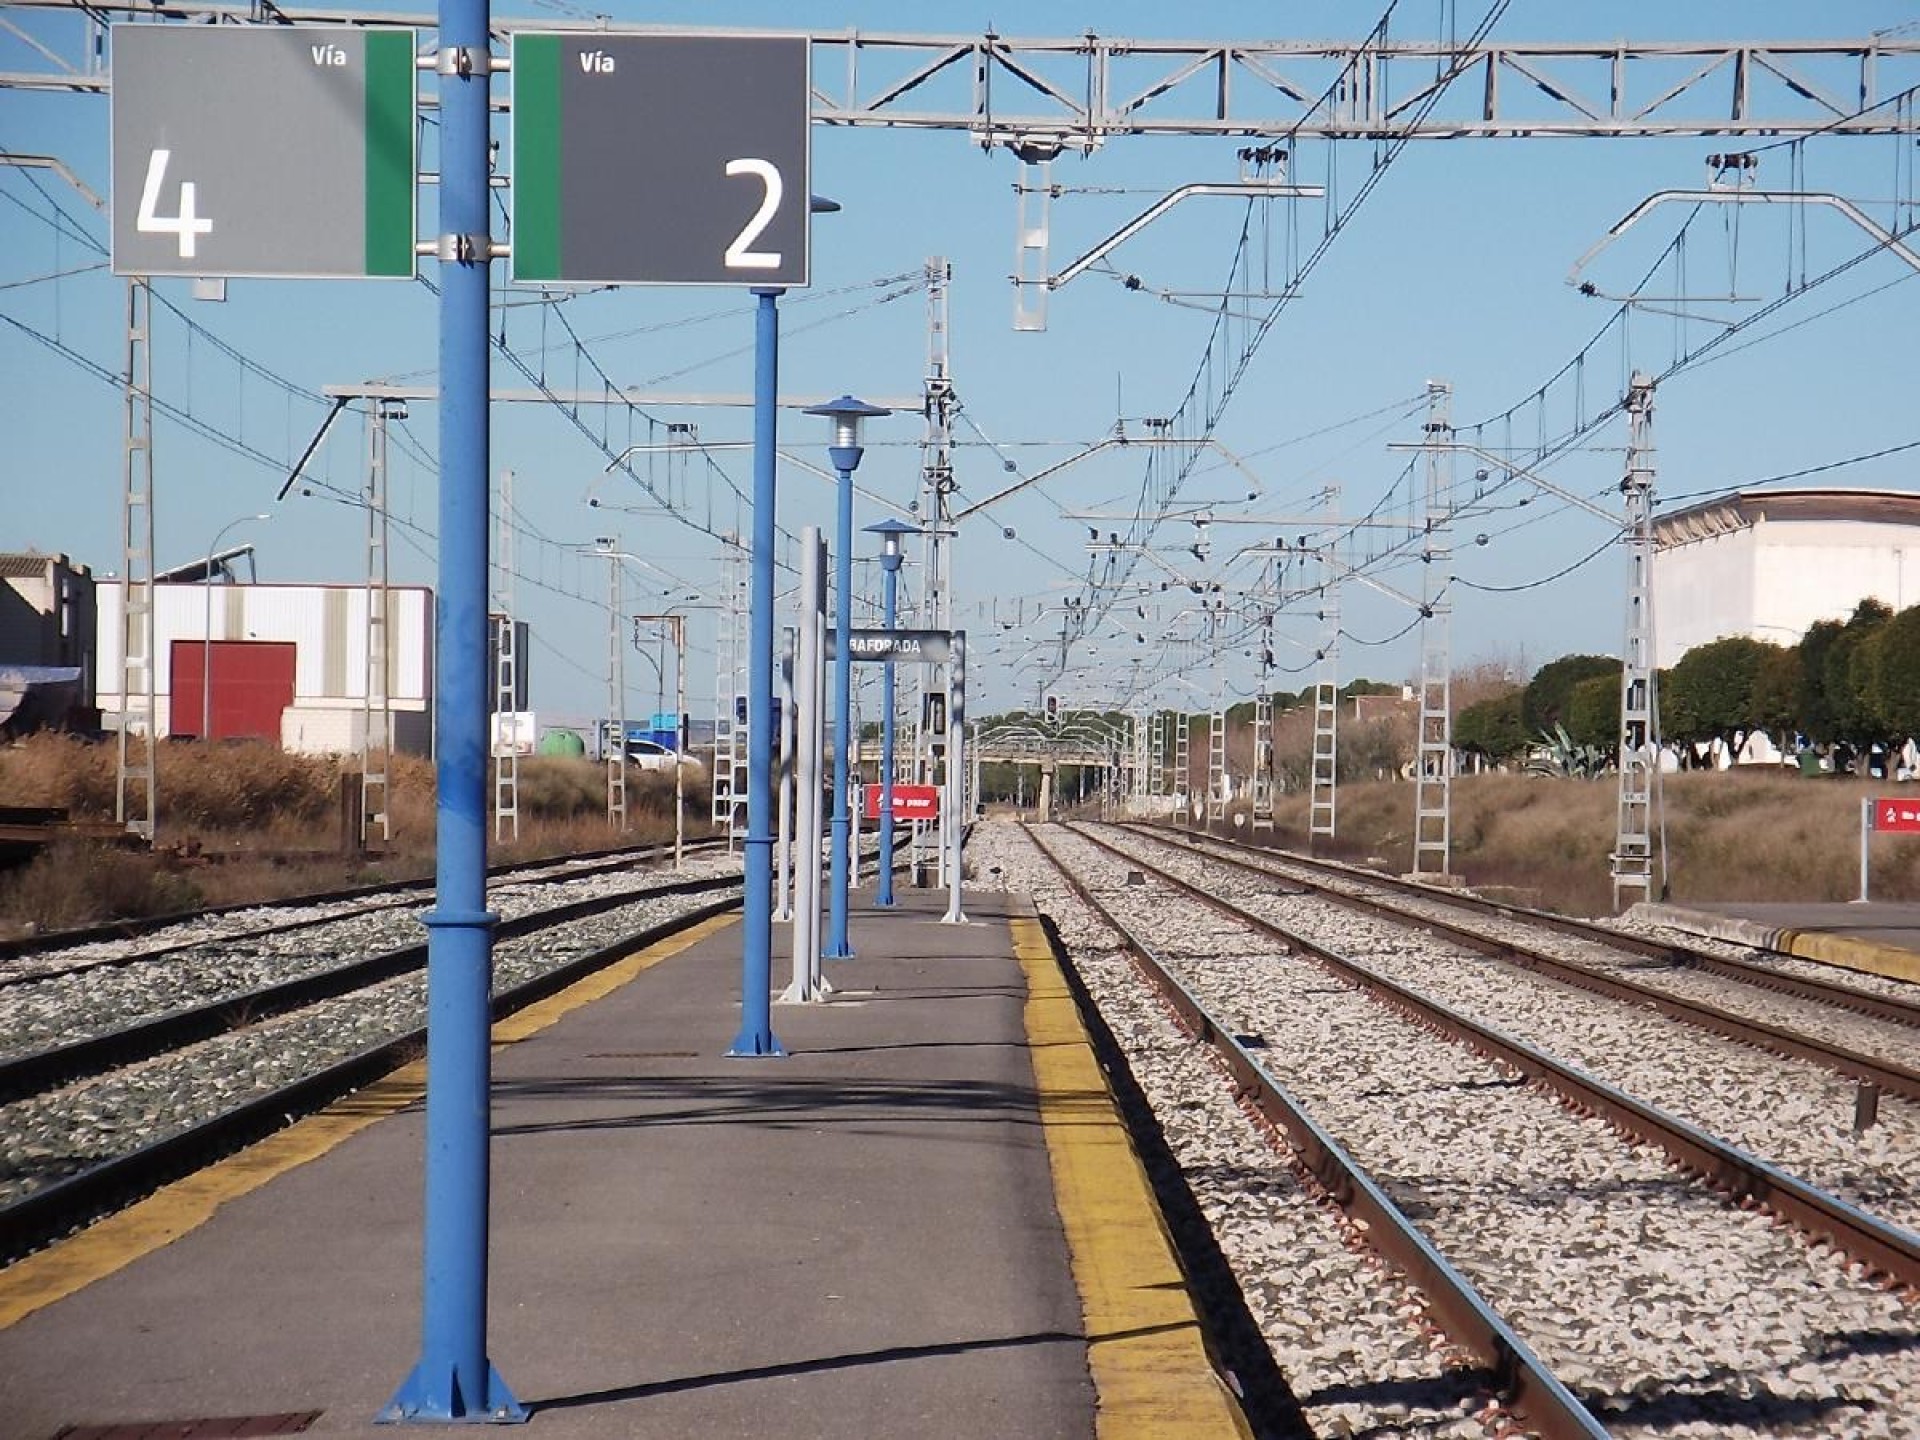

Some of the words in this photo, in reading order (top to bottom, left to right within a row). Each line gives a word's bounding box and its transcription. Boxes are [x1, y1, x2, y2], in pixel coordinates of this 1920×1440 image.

[311, 45, 347, 66] Vía
[580, 51, 615, 73] Vía
[136, 149, 213, 258] 4
[724, 158, 782, 269] 2
[849, 638, 921, 654] BAFORADA
